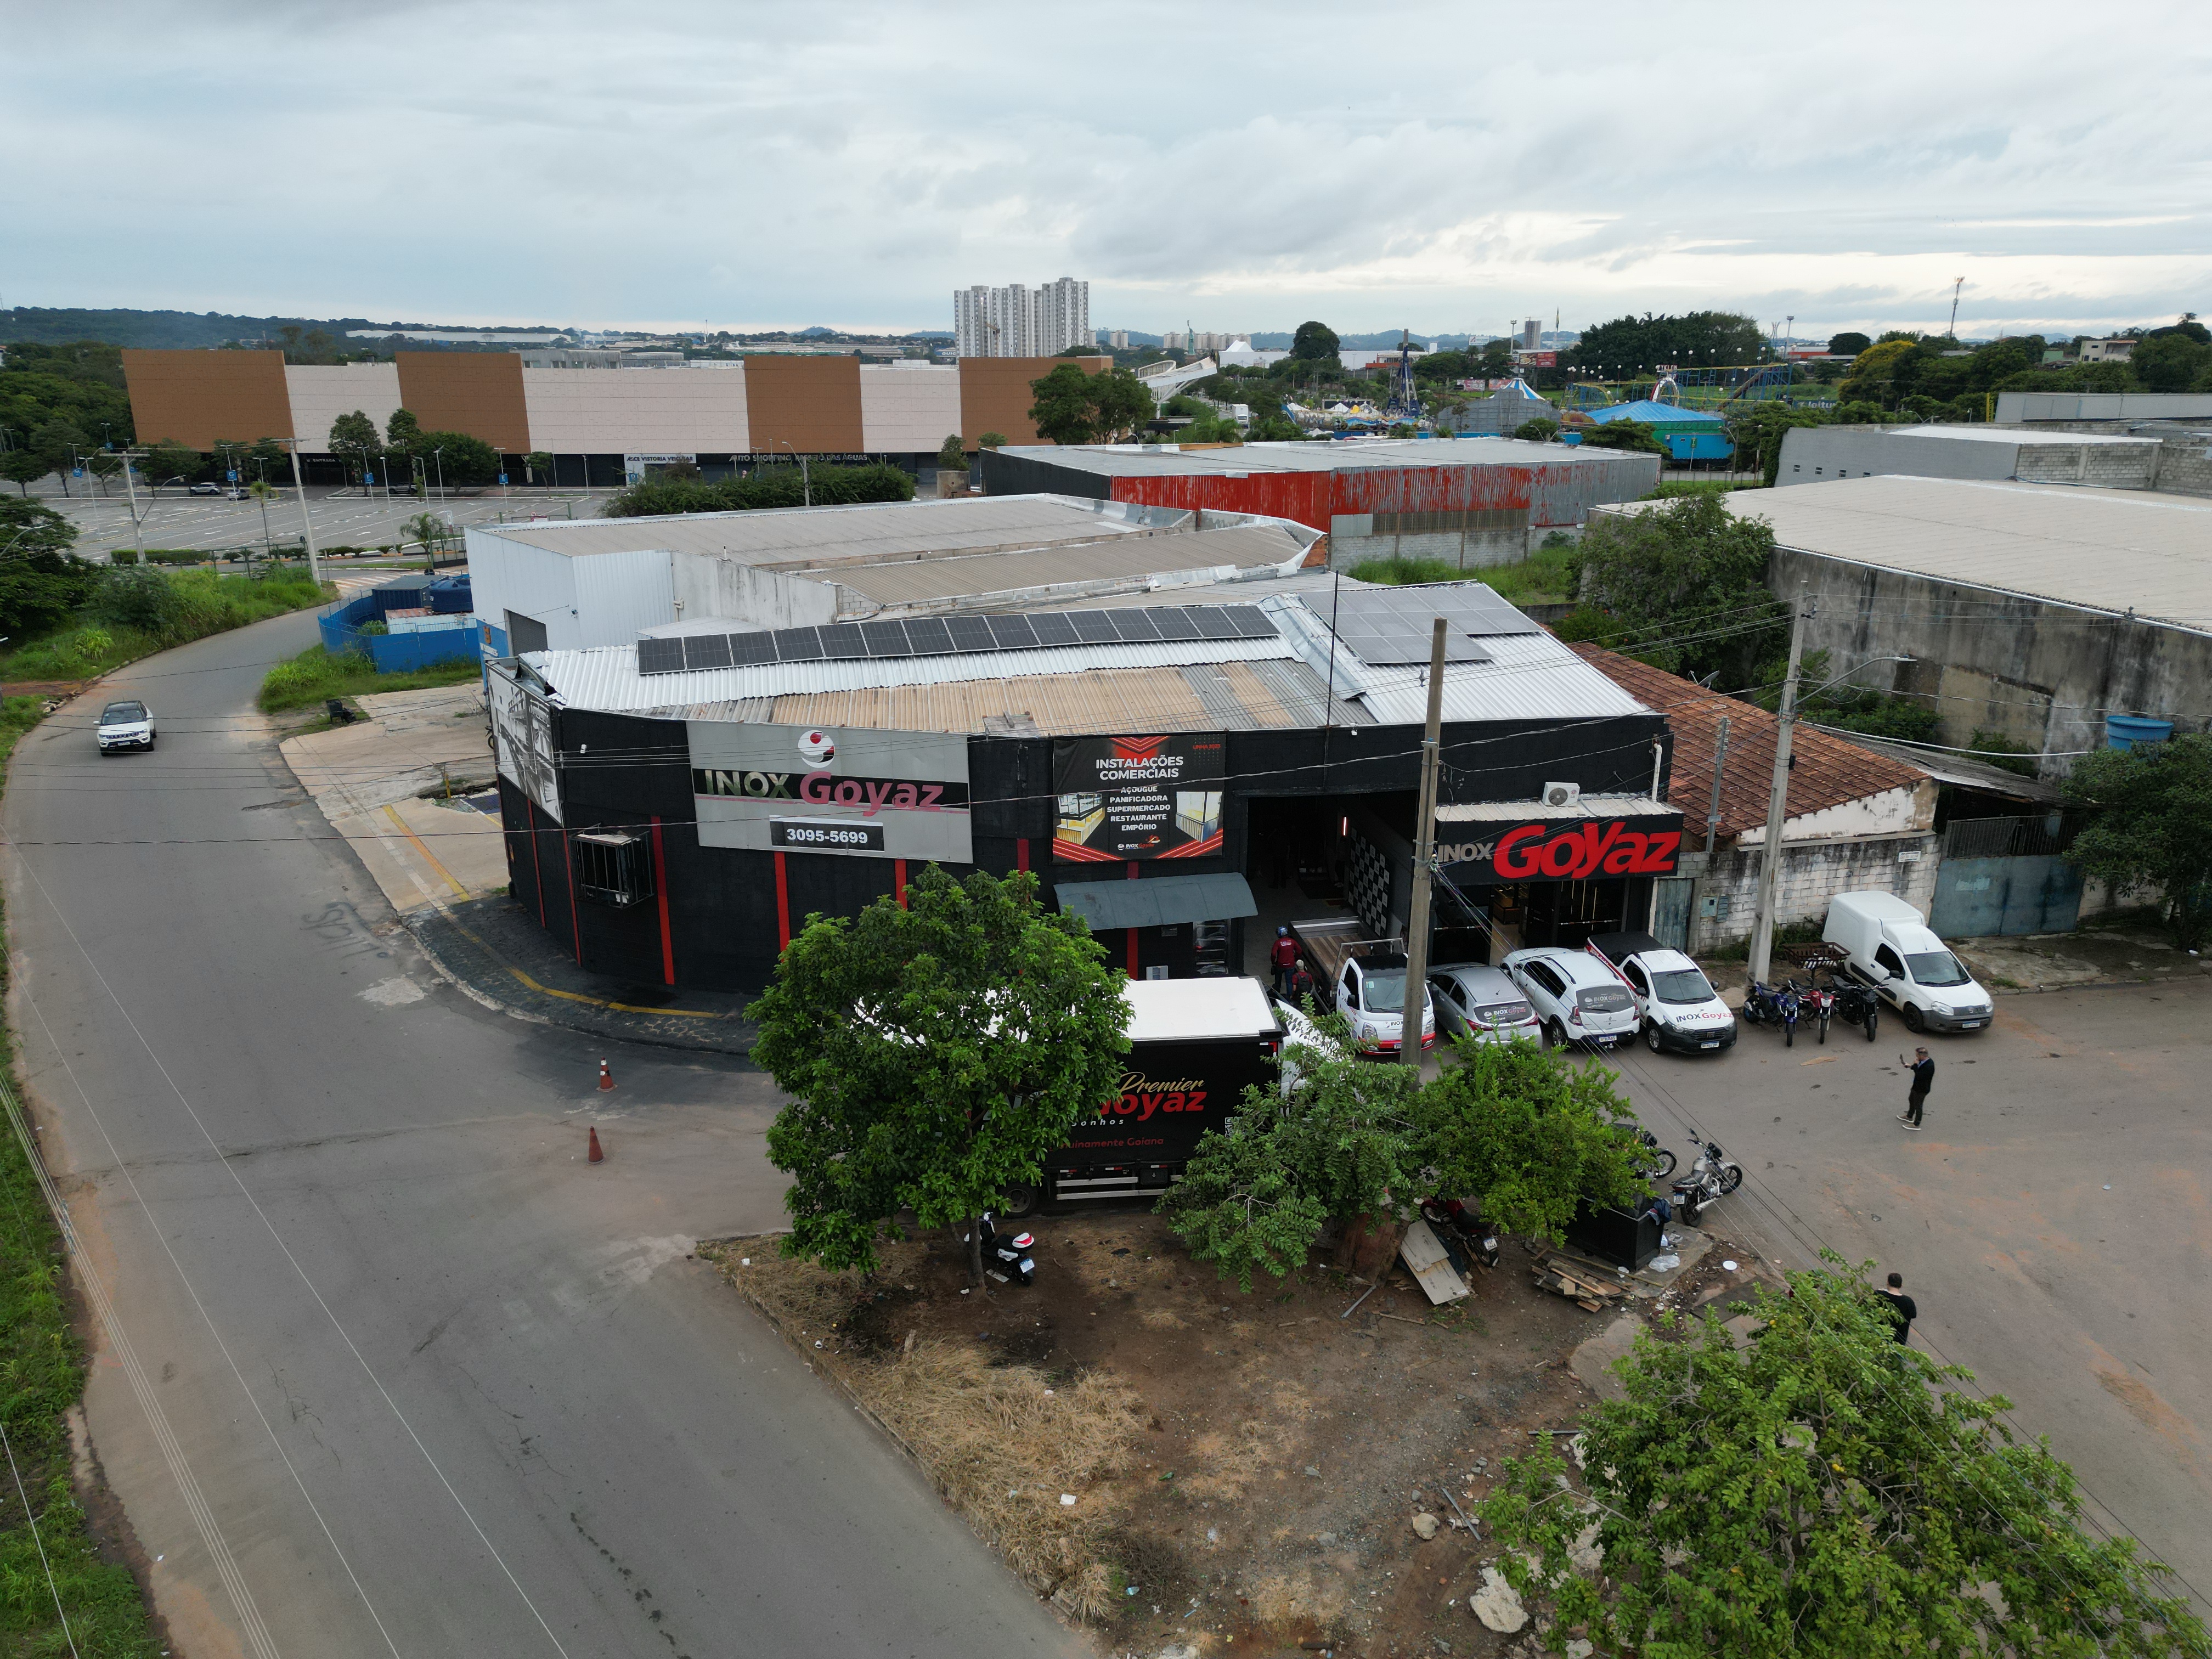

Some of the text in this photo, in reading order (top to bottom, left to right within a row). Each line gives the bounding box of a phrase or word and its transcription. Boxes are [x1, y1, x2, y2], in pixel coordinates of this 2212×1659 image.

[1096, 755, 1184, 769] INSTALAÇÕES
[1099, 768, 1179, 780] COMERCIAIS
[704, 769, 944, 817] INOX Goyaz
[1120, 786, 1158, 794] AÇOUGUE
[1109, 795, 1168, 803] PANIFICADORA
[1107, 804, 1171, 812] SUPERMERCADO
[1110, 814, 1167, 822] RESTAURANTE
[1121, 823, 1157, 831] EMPÓRIO
[786, 828, 868, 844] 3095-5699
[1437, 842, 1496, 863] INOX
[1676, 1013, 1701, 1023] INOX
[1120, 1071, 1205, 1094] Premier
[1127, 1137, 1164, 1146] Goiana
